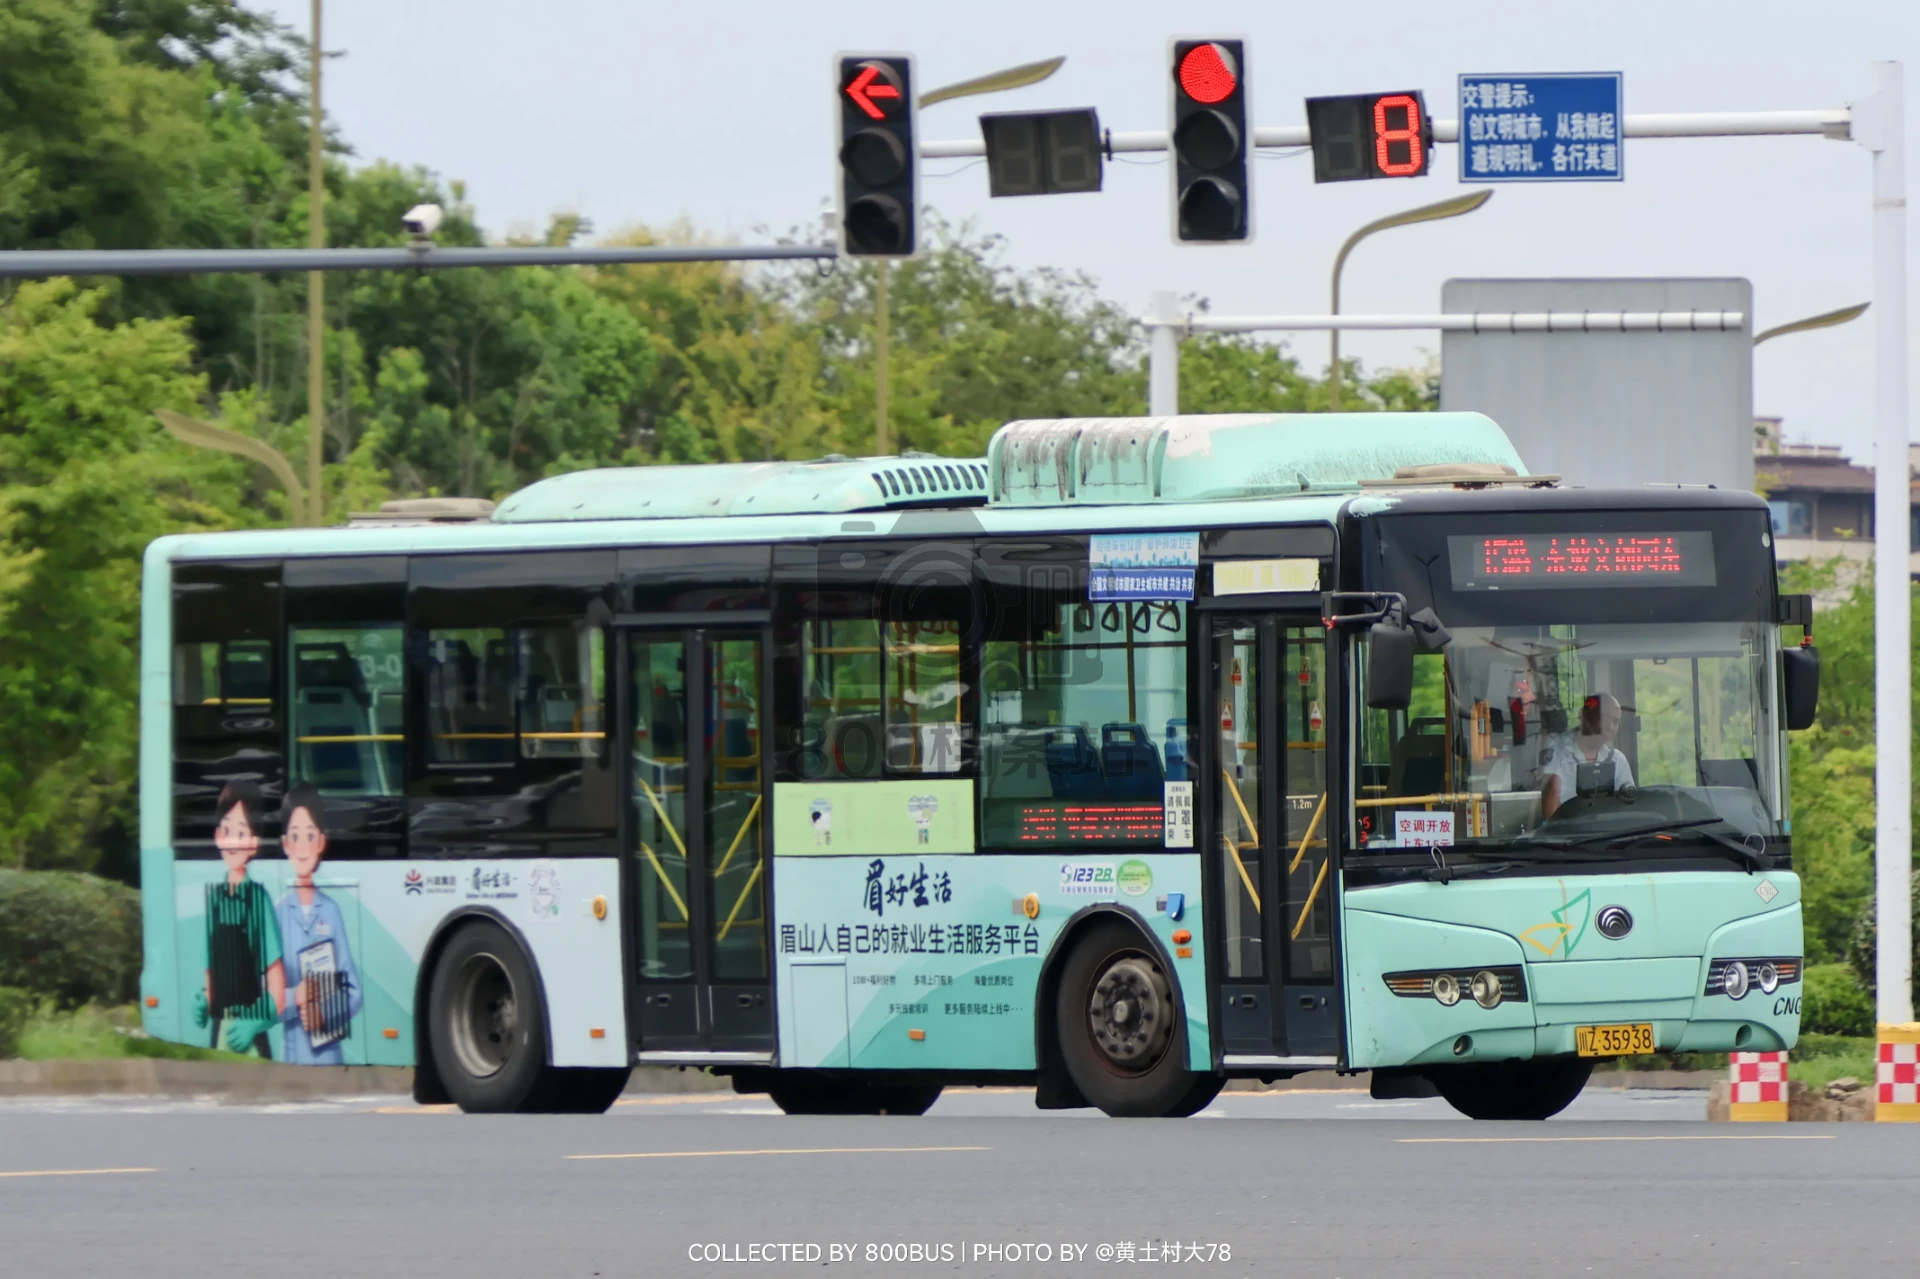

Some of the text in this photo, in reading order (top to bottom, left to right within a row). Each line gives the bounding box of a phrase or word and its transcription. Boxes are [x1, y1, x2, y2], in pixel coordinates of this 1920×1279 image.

[1374, 95, 1422, 176] 8
[1292, 799, 1313, 810] 1.2m
[1399, 819, 1451, 833] 空调开放
[1073, 868, 1113, 882] 12328
[863, 858, 952, 917] 眉好生活
[780, 923, 1039, 955] 眉山人自己的就业生活服务平台
[1773, 997, 1801, 1016] CNG
